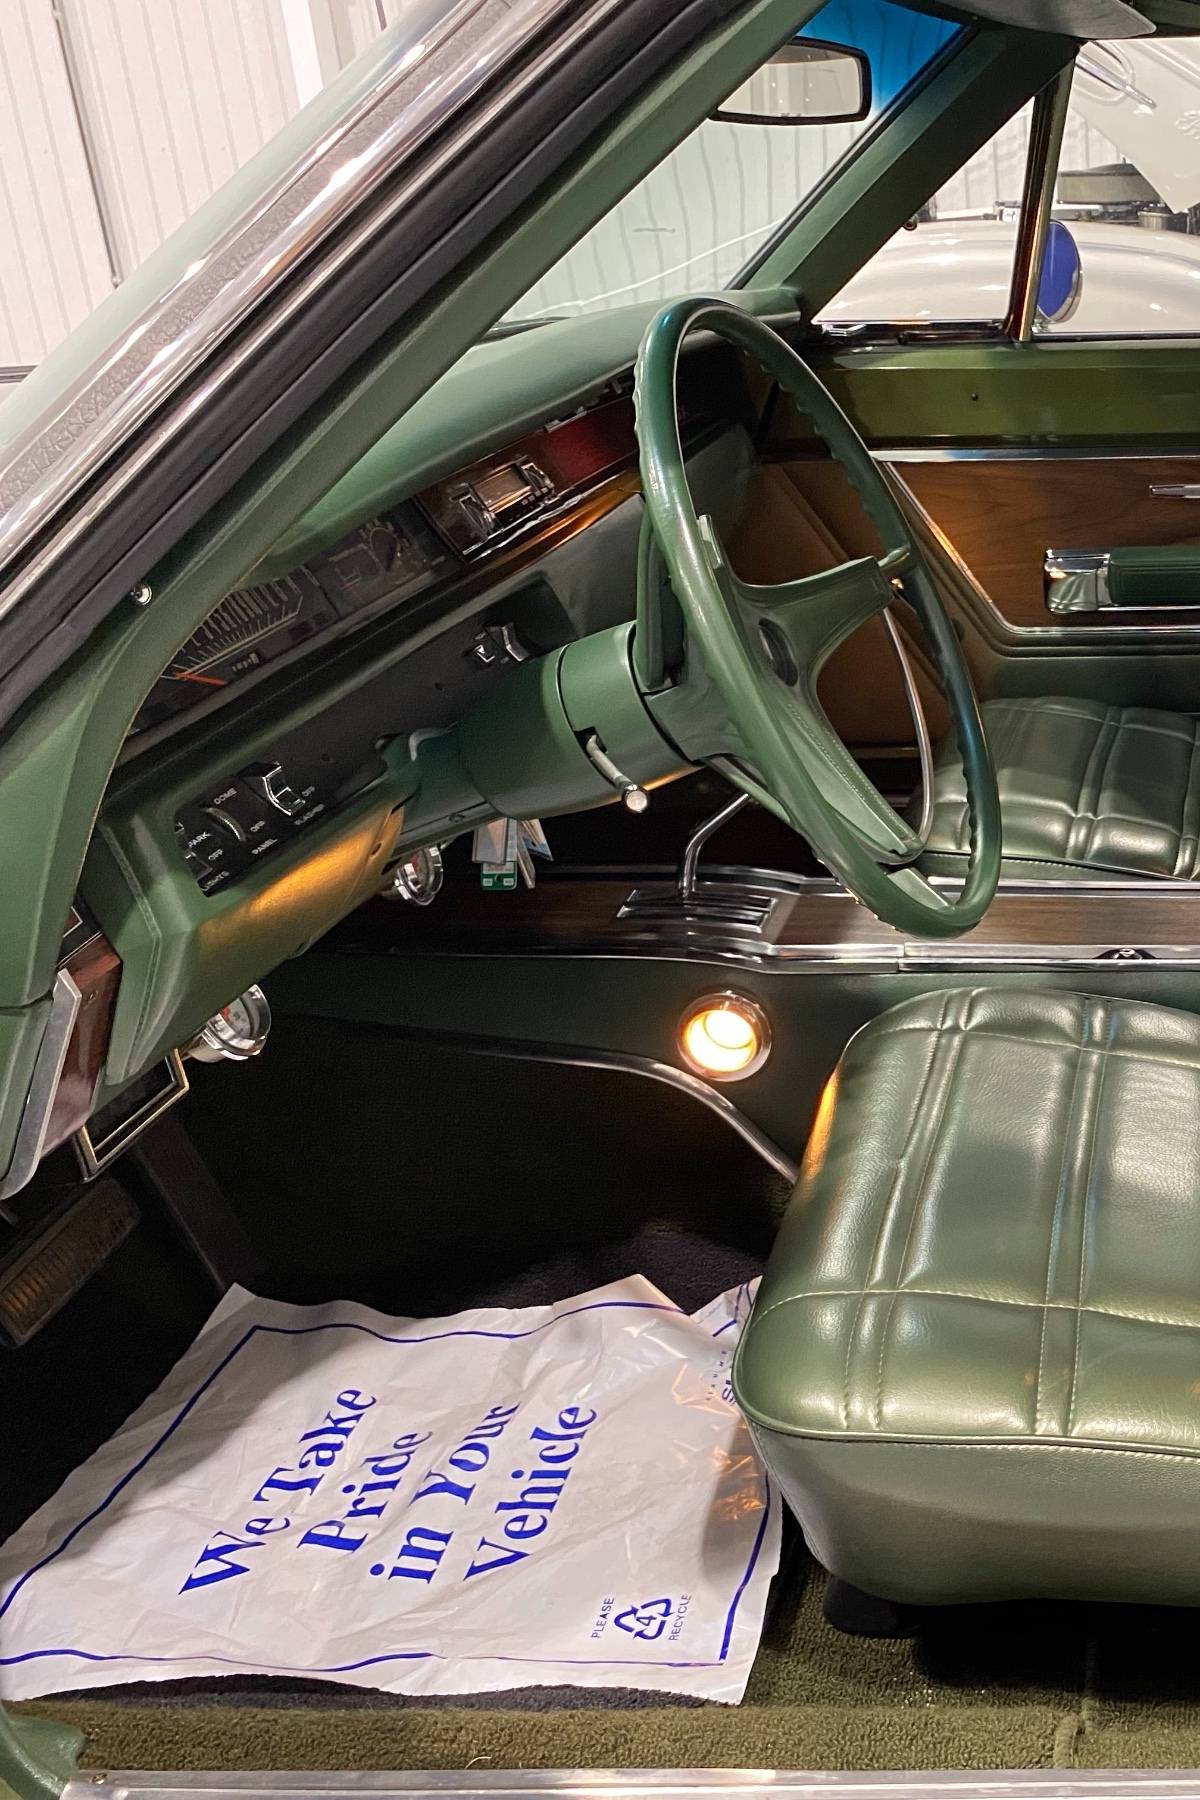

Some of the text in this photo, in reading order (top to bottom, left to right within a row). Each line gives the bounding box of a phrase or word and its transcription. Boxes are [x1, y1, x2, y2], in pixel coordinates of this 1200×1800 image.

[214, 787, 238, 804] DOME
[188, 831, 212, 848] PARK
[250, 820, 266, 832] OFF
[208, 848, 224, 861] OFF
[251, 838, 278, 855] PANEL
[178, 1389, 376, 1596] We Take
[297, 1432, 433, 1553] Pride
[369, 1403, 520, 1585] in Your
[463, 1406, 597, 1581] Vehicle
[591, 1597, 616, 1639] PLEASE
[636, 1615, 657, 1626] 4
[668, 1594, 692, 1641] RECYCLE
